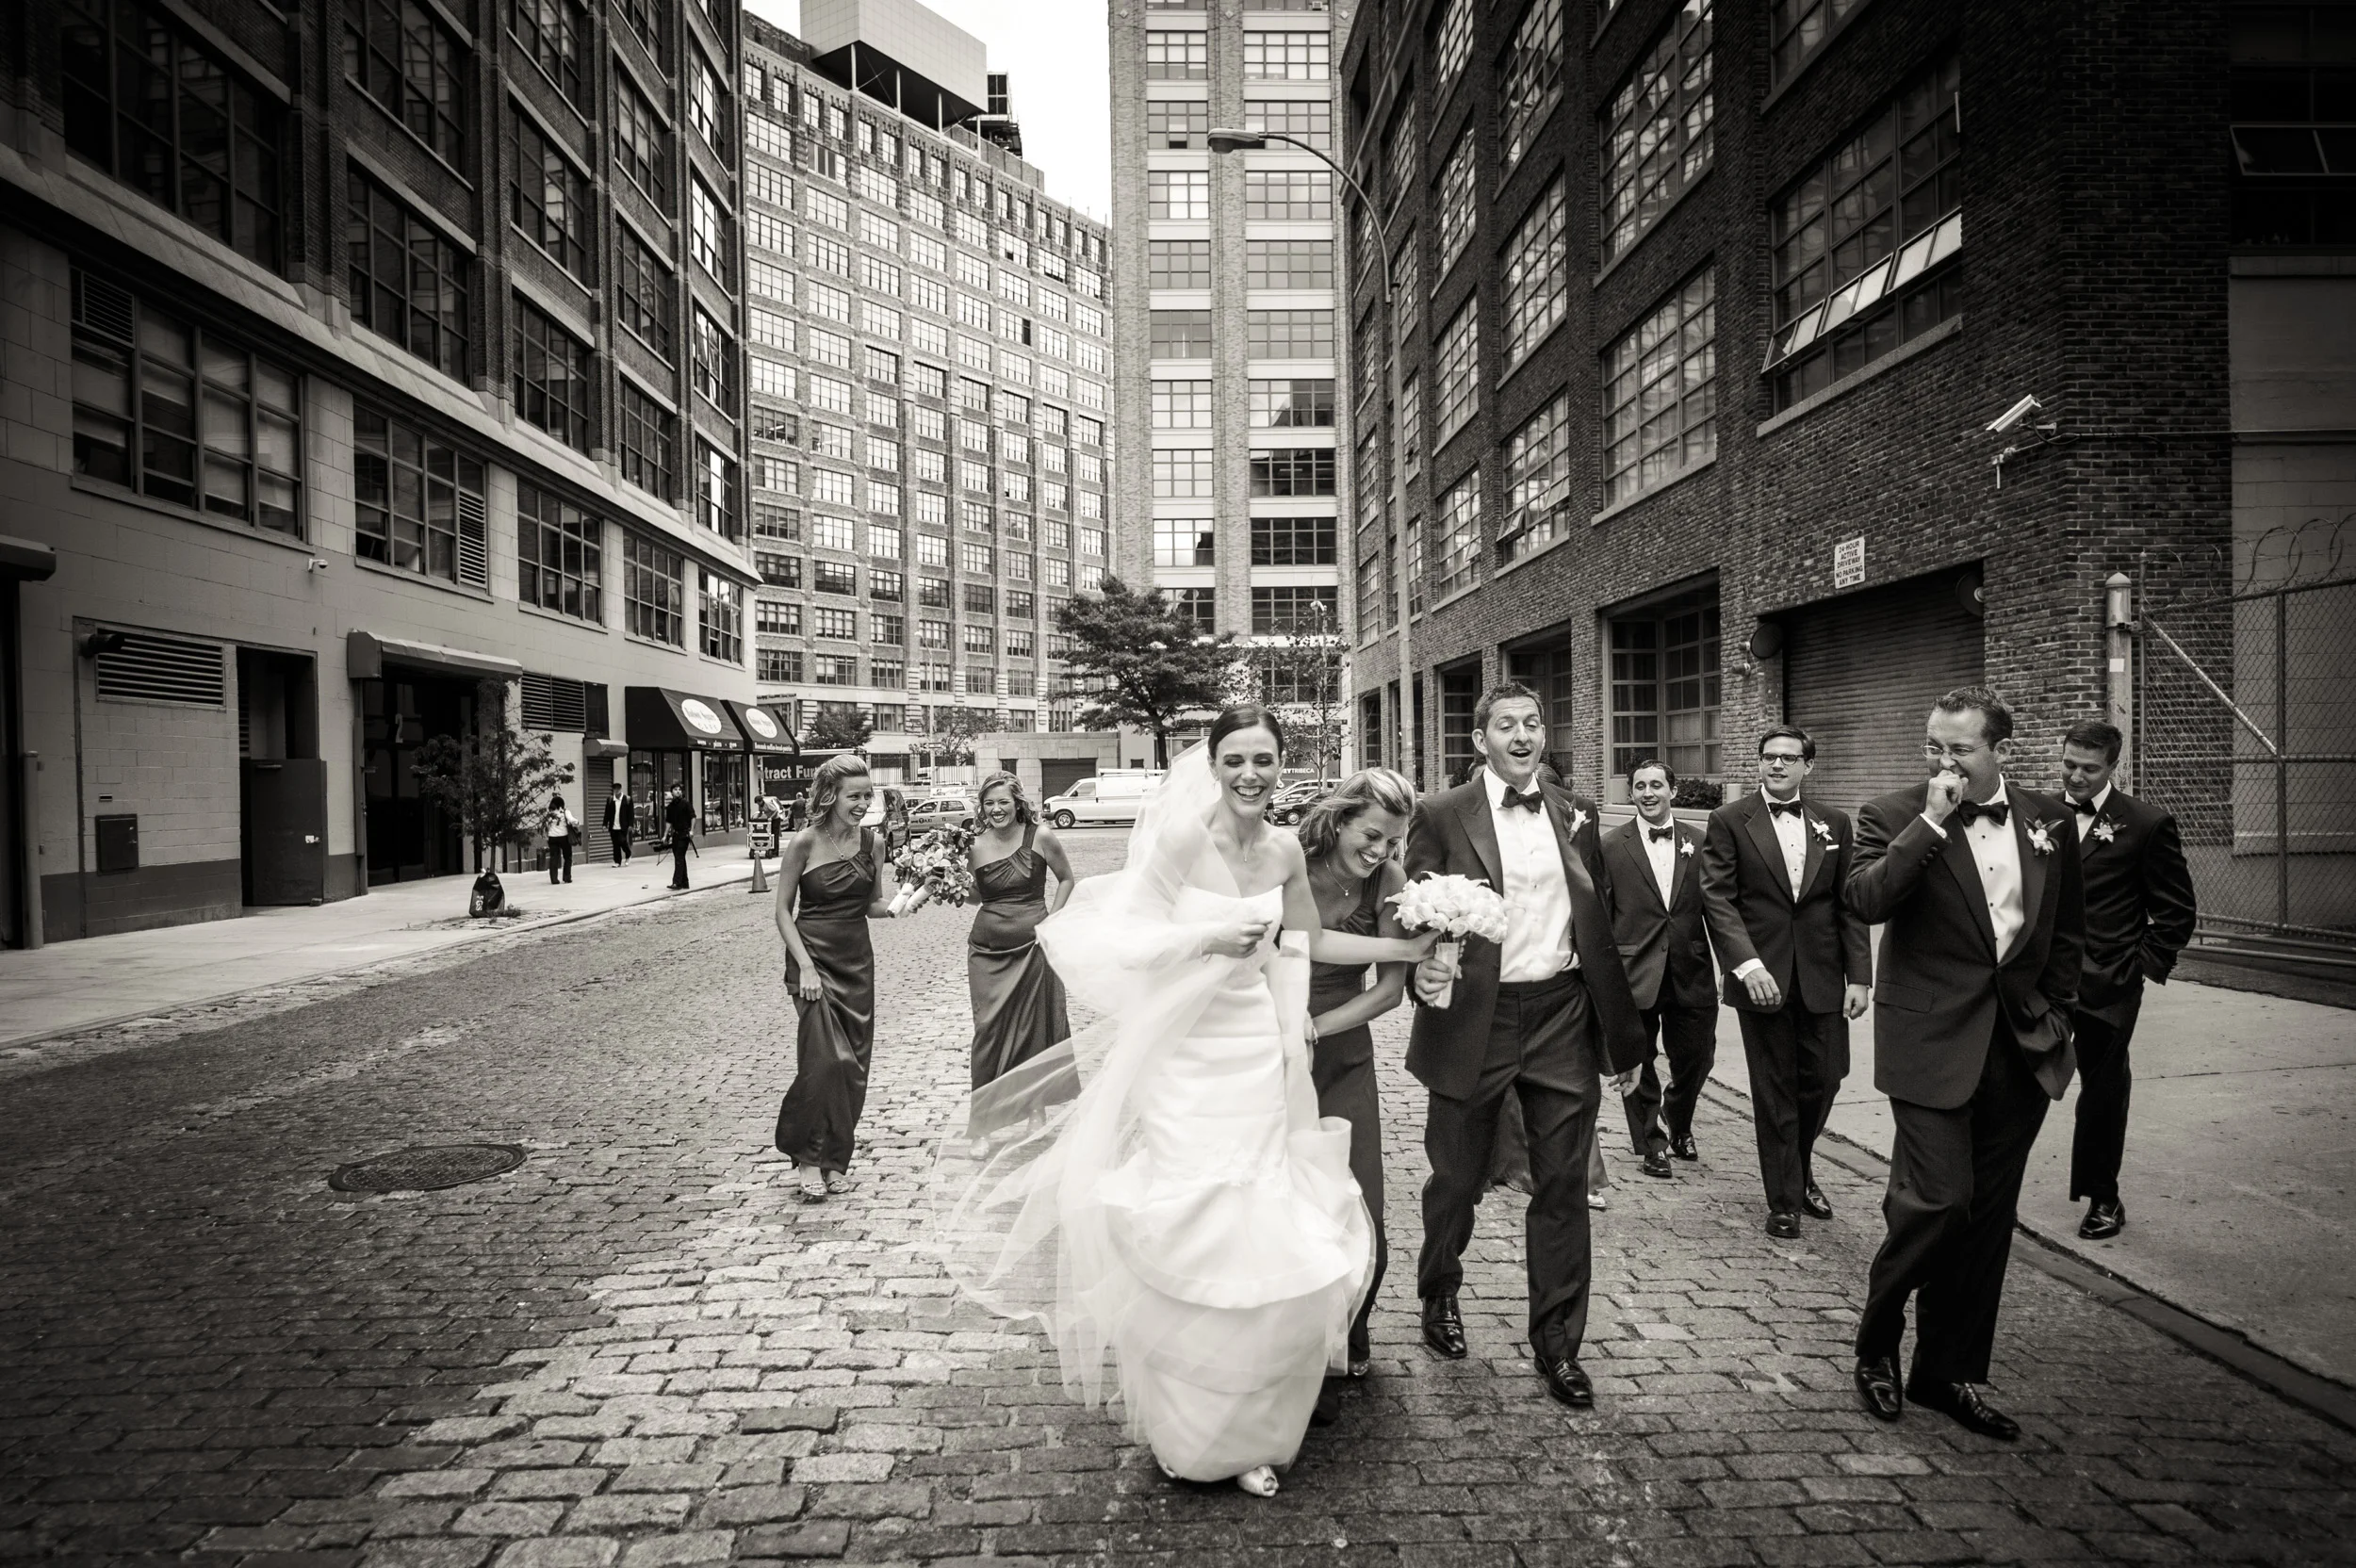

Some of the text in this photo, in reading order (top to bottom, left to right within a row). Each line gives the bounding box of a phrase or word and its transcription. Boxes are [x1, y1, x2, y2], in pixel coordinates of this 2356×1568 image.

[1839, 541, 1859, 553] 24-HOUR
[1841, 549, 1857, 560] ACTIVE
[1837, 556, 1861, 568] DRIVEWAY
[1836, 565, 1863, 579] NO PARKING
[1839, 574, 1860, 585] ANY TIME
[795, 764, 816, 778] Fur
